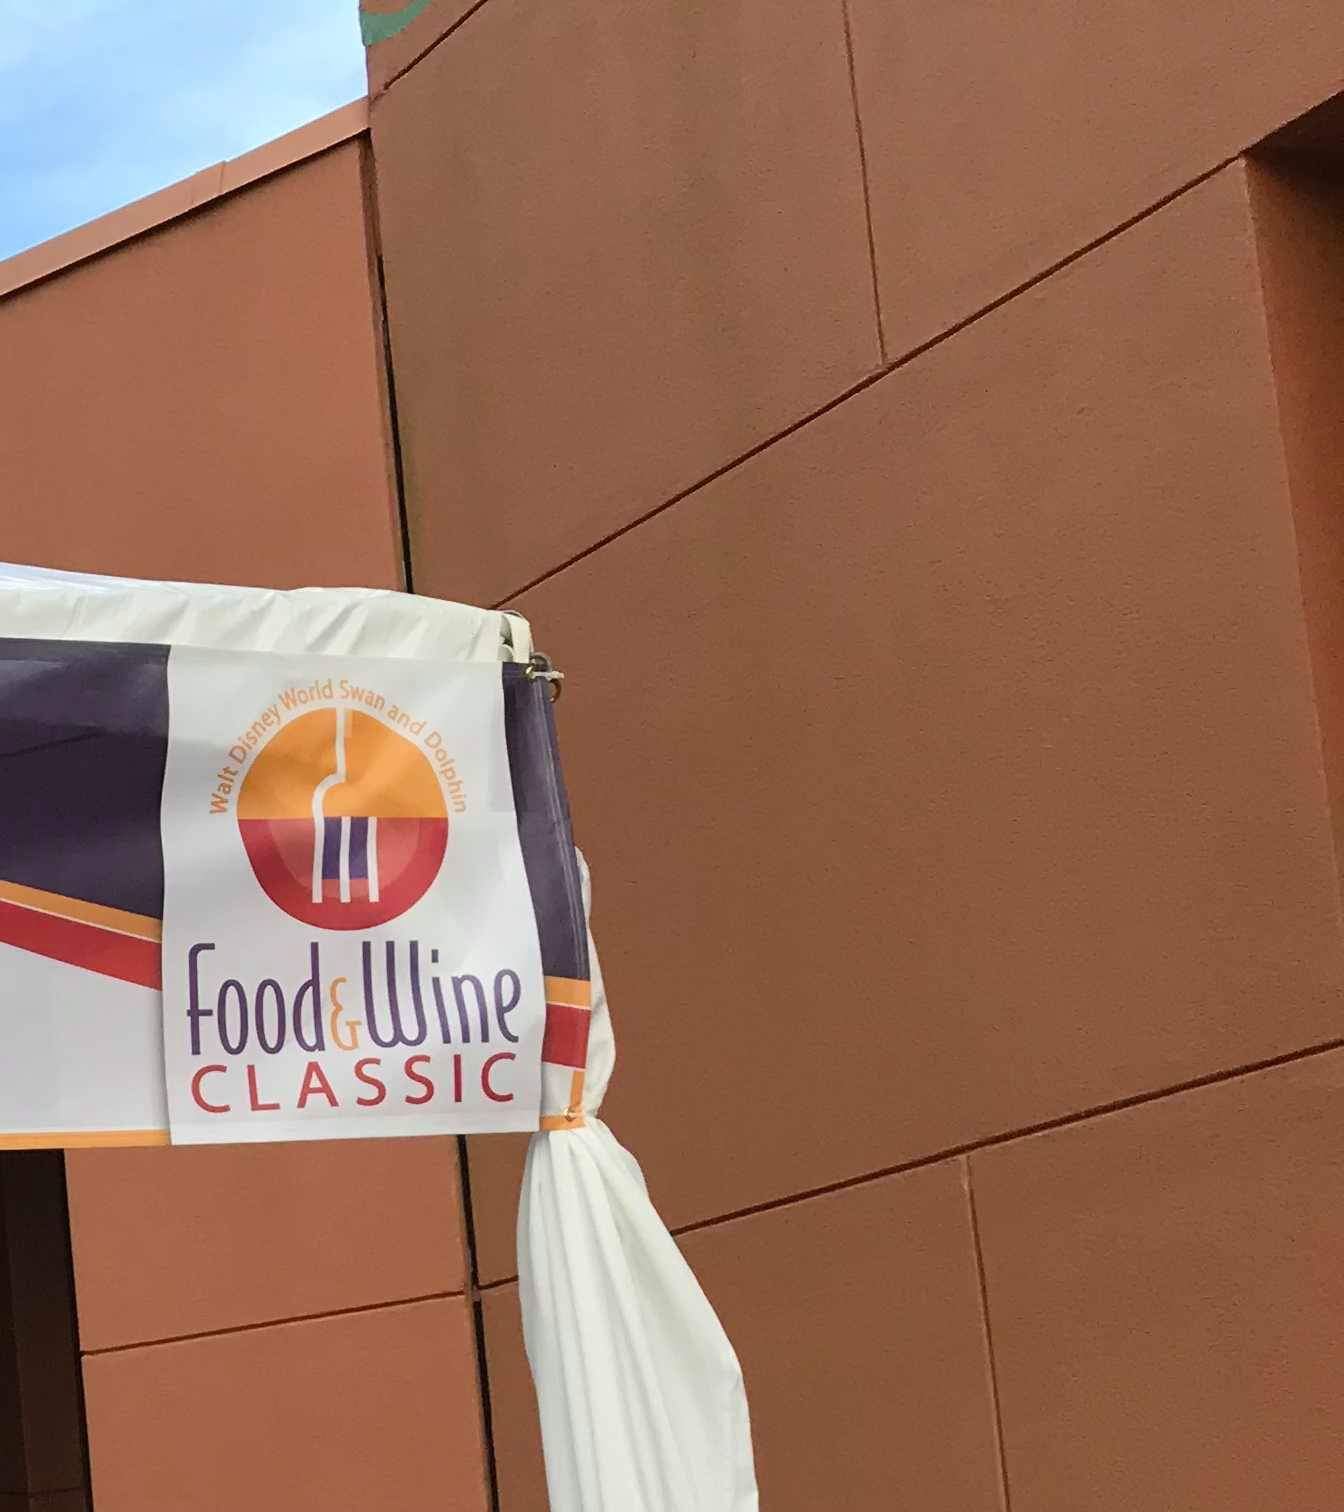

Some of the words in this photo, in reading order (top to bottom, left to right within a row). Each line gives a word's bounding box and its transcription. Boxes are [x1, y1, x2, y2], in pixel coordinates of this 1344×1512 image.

[209, 765, 238, 815] Walt
[228, 703, 282, 765] Disney
[278, 678, 333, 711] World
[339, 680, 387, 712] Swan
[386, 703, 428, 735] and
[424, 730, 467, 813] Dolphin
[362, 940, 522, 1049] Wine
[190, 1052, 517, 1113] CLASSIC
